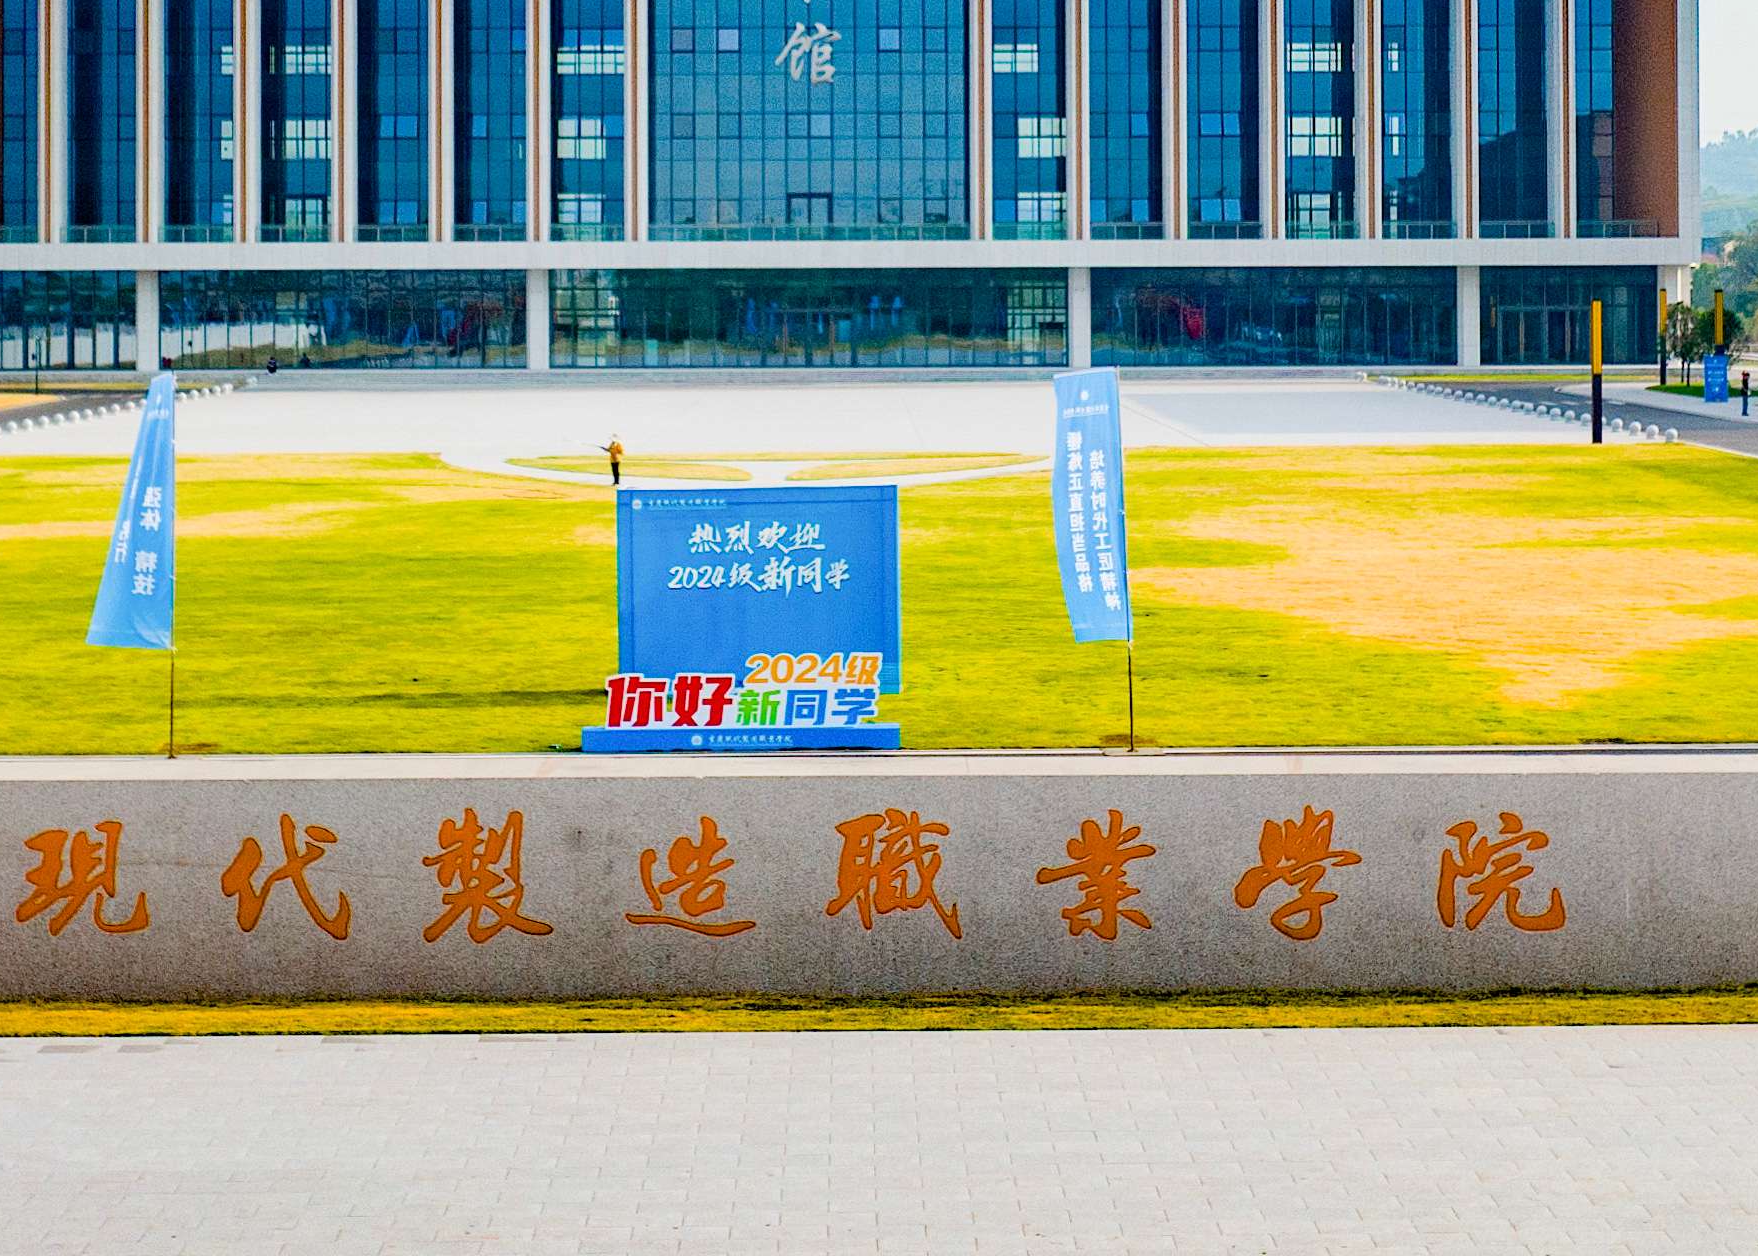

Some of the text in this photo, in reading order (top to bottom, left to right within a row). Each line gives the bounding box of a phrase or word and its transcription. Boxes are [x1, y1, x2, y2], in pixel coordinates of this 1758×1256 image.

[688, 521, 825, 554] 热烈欢迎
[667, 556, 850, 597] 2024级新同学
[745, 654, 880, 685] 2024级
